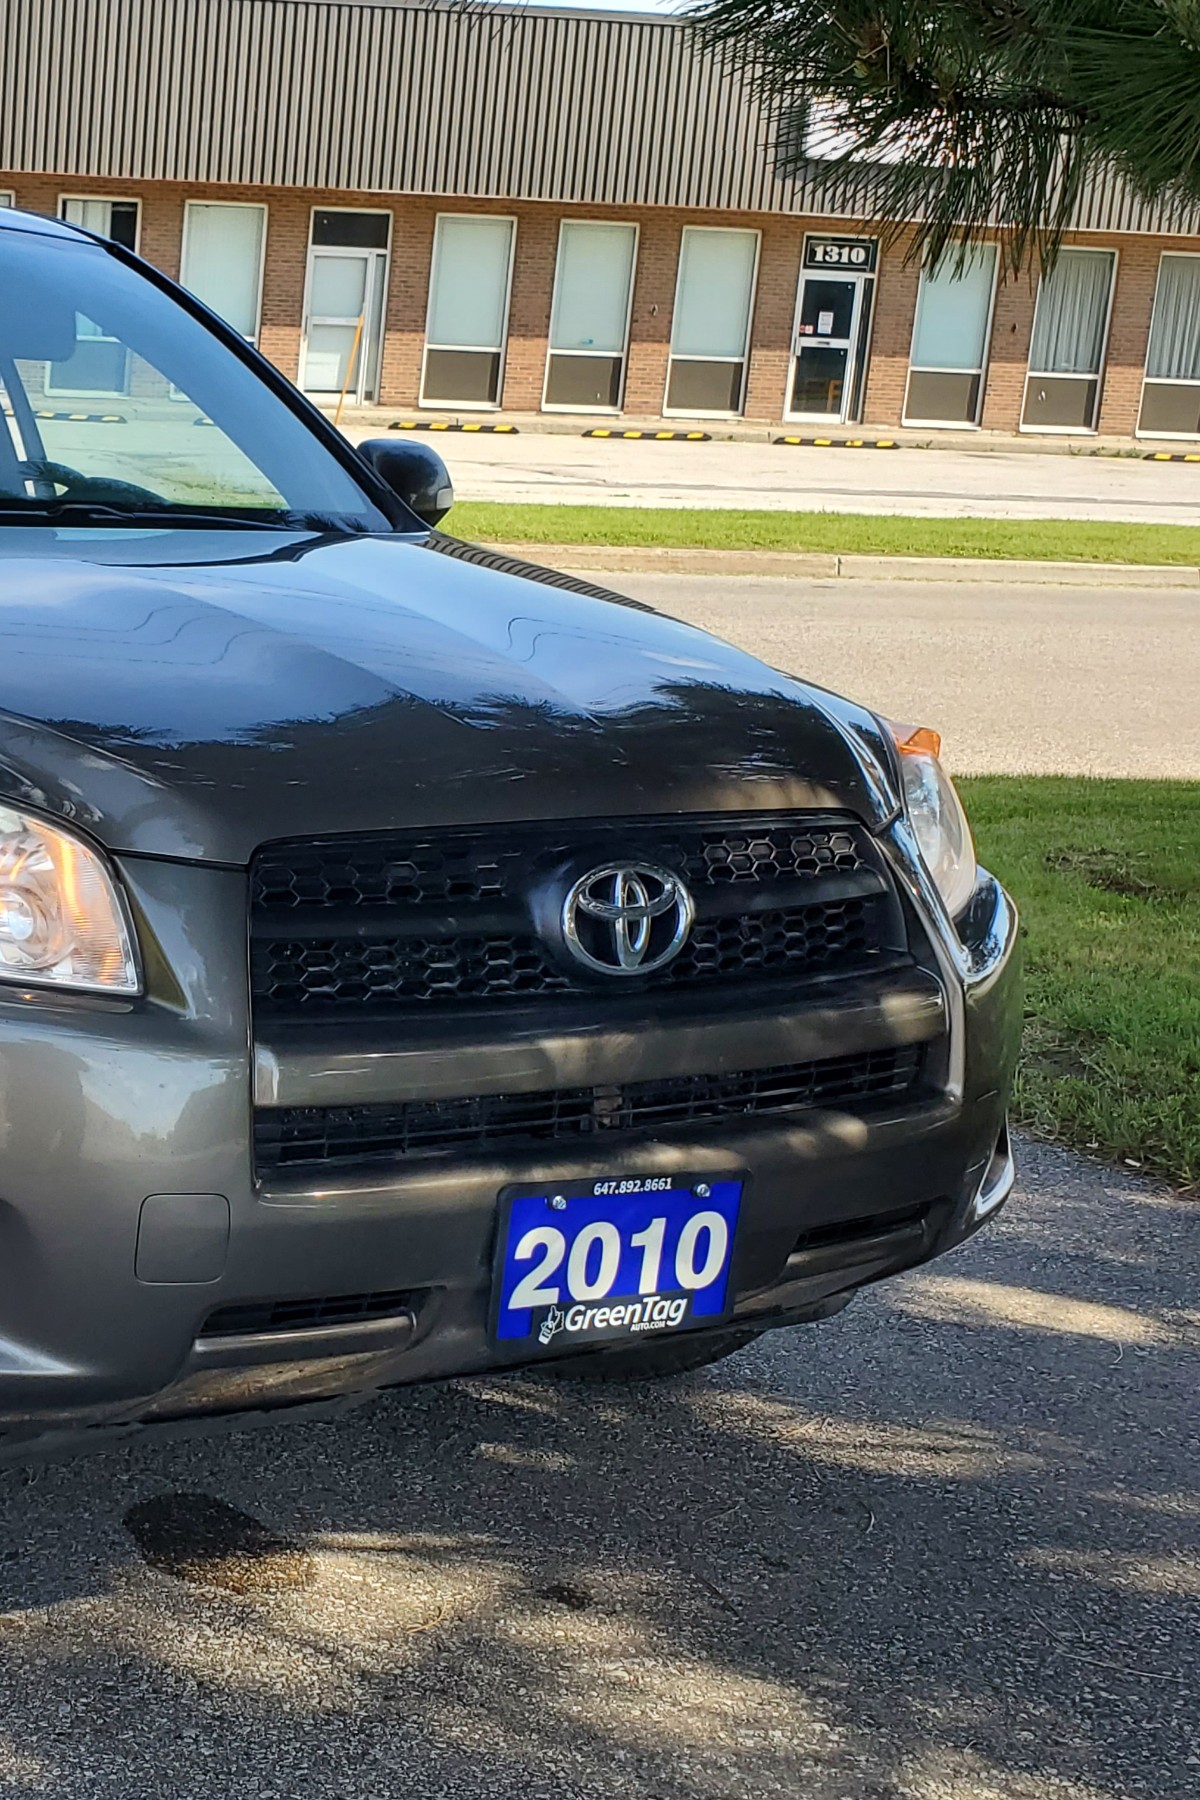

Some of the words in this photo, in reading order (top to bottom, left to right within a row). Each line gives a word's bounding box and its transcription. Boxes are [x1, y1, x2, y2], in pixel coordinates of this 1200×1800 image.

[814, 244, 866, 264] 1310
[593, 1177, 672, 1196] 647.892.8661
[508, 1211, 728, 1310] 2010
[565, 1296, 688, 1332] GreenTag
[630, 1320, 666, 1332] AUTO.COM
